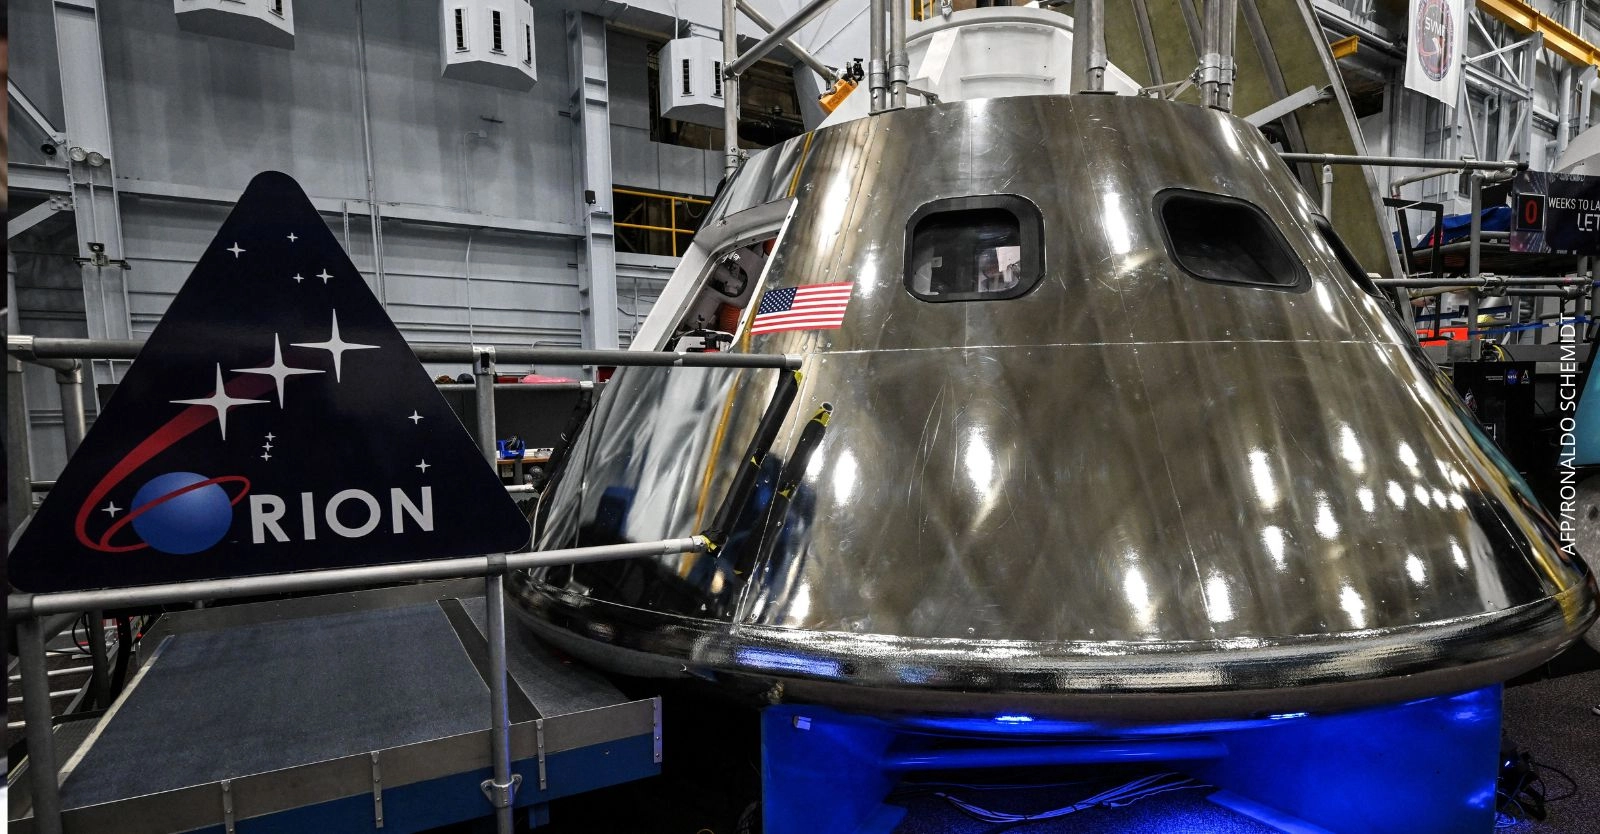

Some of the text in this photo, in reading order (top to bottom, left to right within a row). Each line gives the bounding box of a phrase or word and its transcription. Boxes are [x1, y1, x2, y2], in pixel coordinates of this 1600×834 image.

[1525, 199, 1538, 225] 0
[1548, 196, 1576, 210] WEEKS
[1578, 198, 1589, 210] TO
